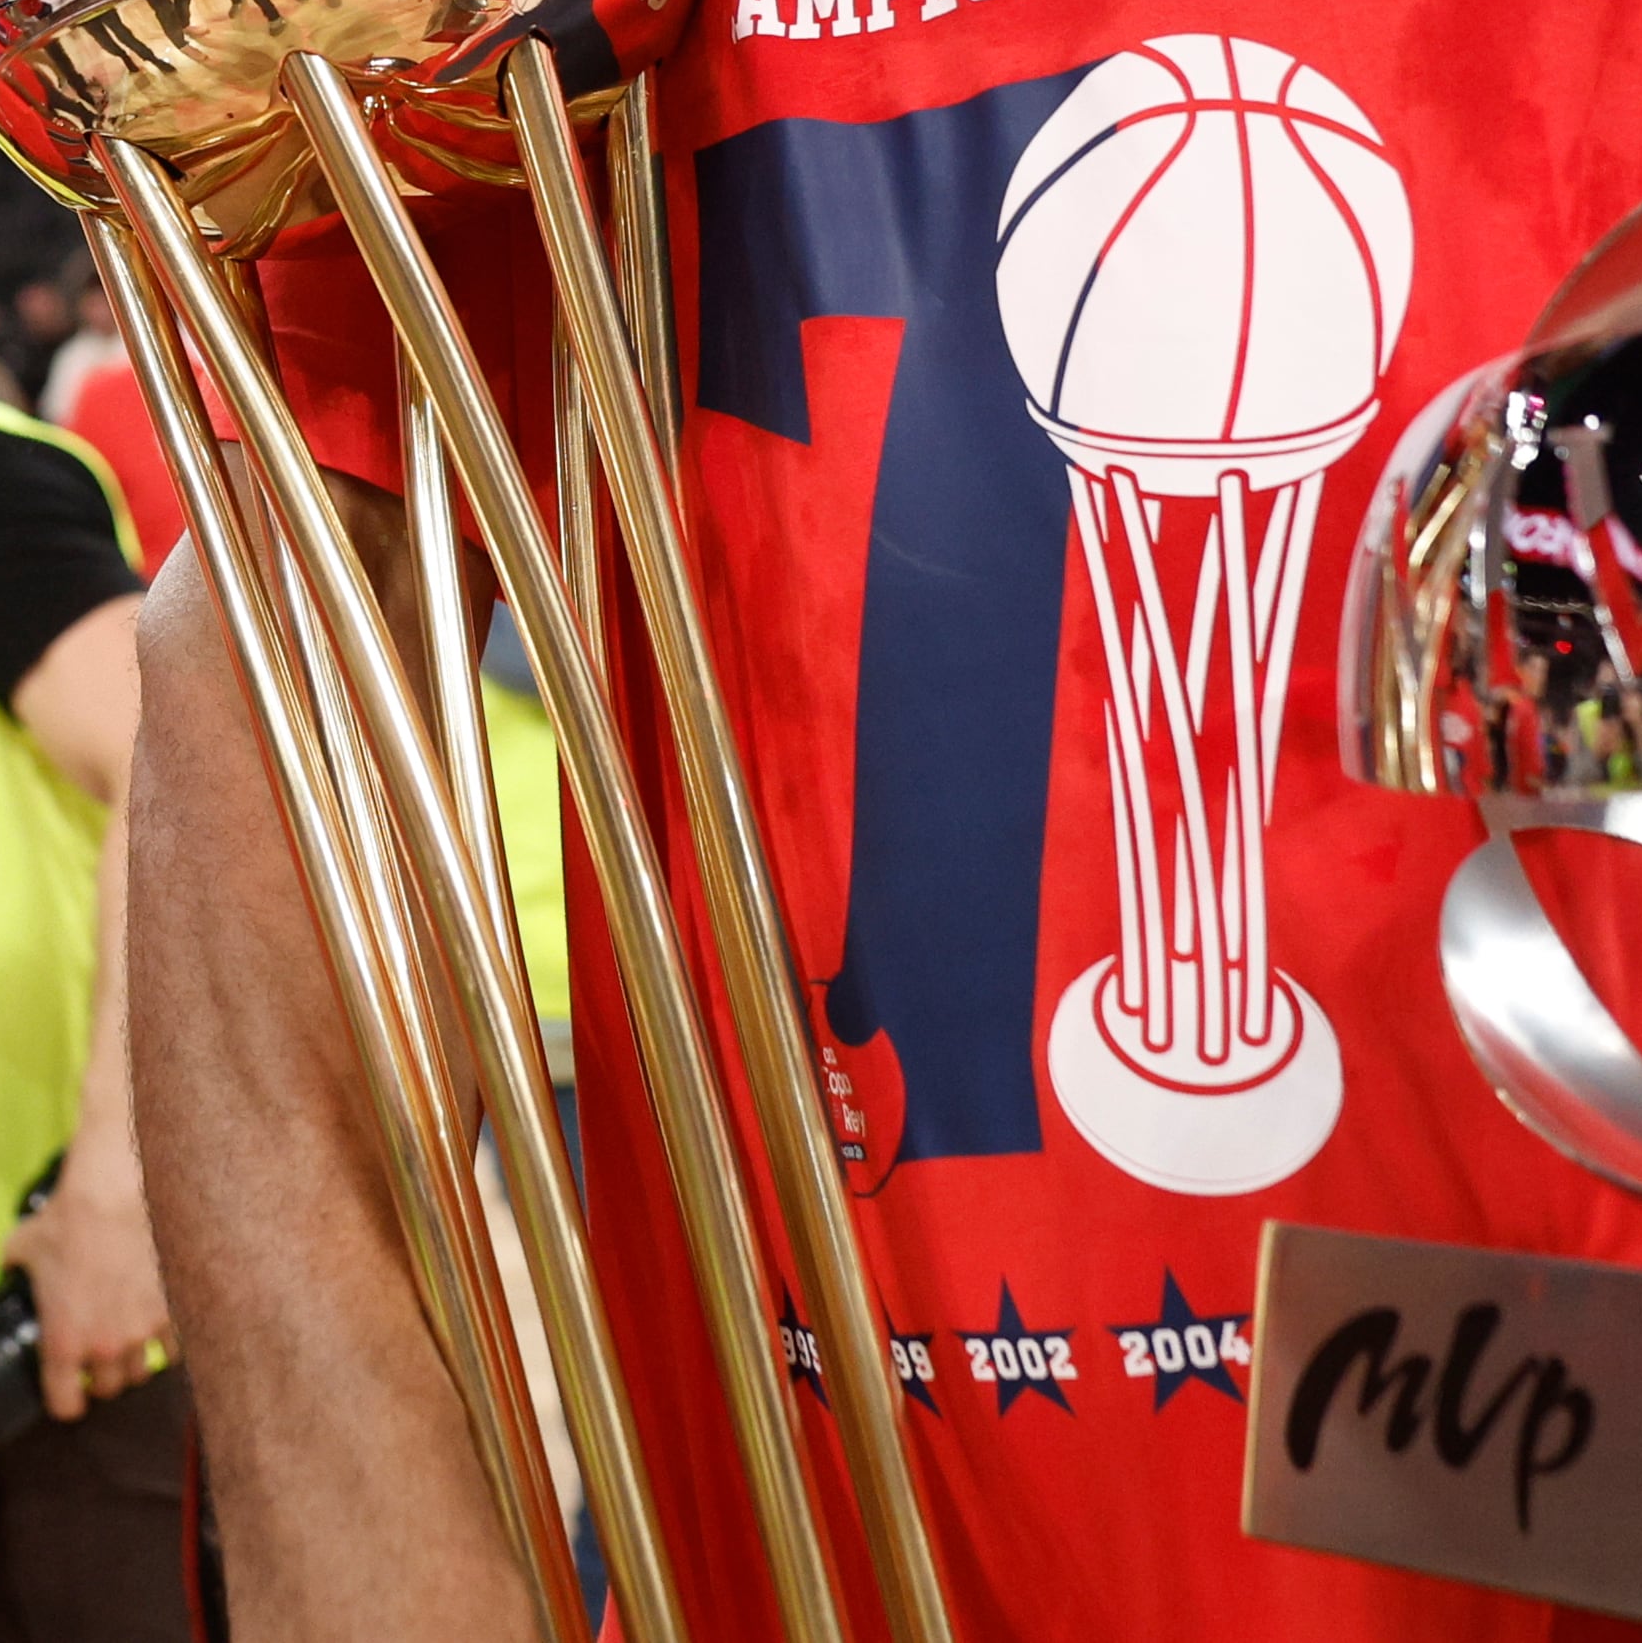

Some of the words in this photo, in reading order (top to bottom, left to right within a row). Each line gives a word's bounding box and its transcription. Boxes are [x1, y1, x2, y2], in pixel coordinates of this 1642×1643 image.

[890, 1338, 935, 1382] 99
[964, 1336, 1079, 1381] 2002
[1118, 1320, 1253, 1379] 2004
